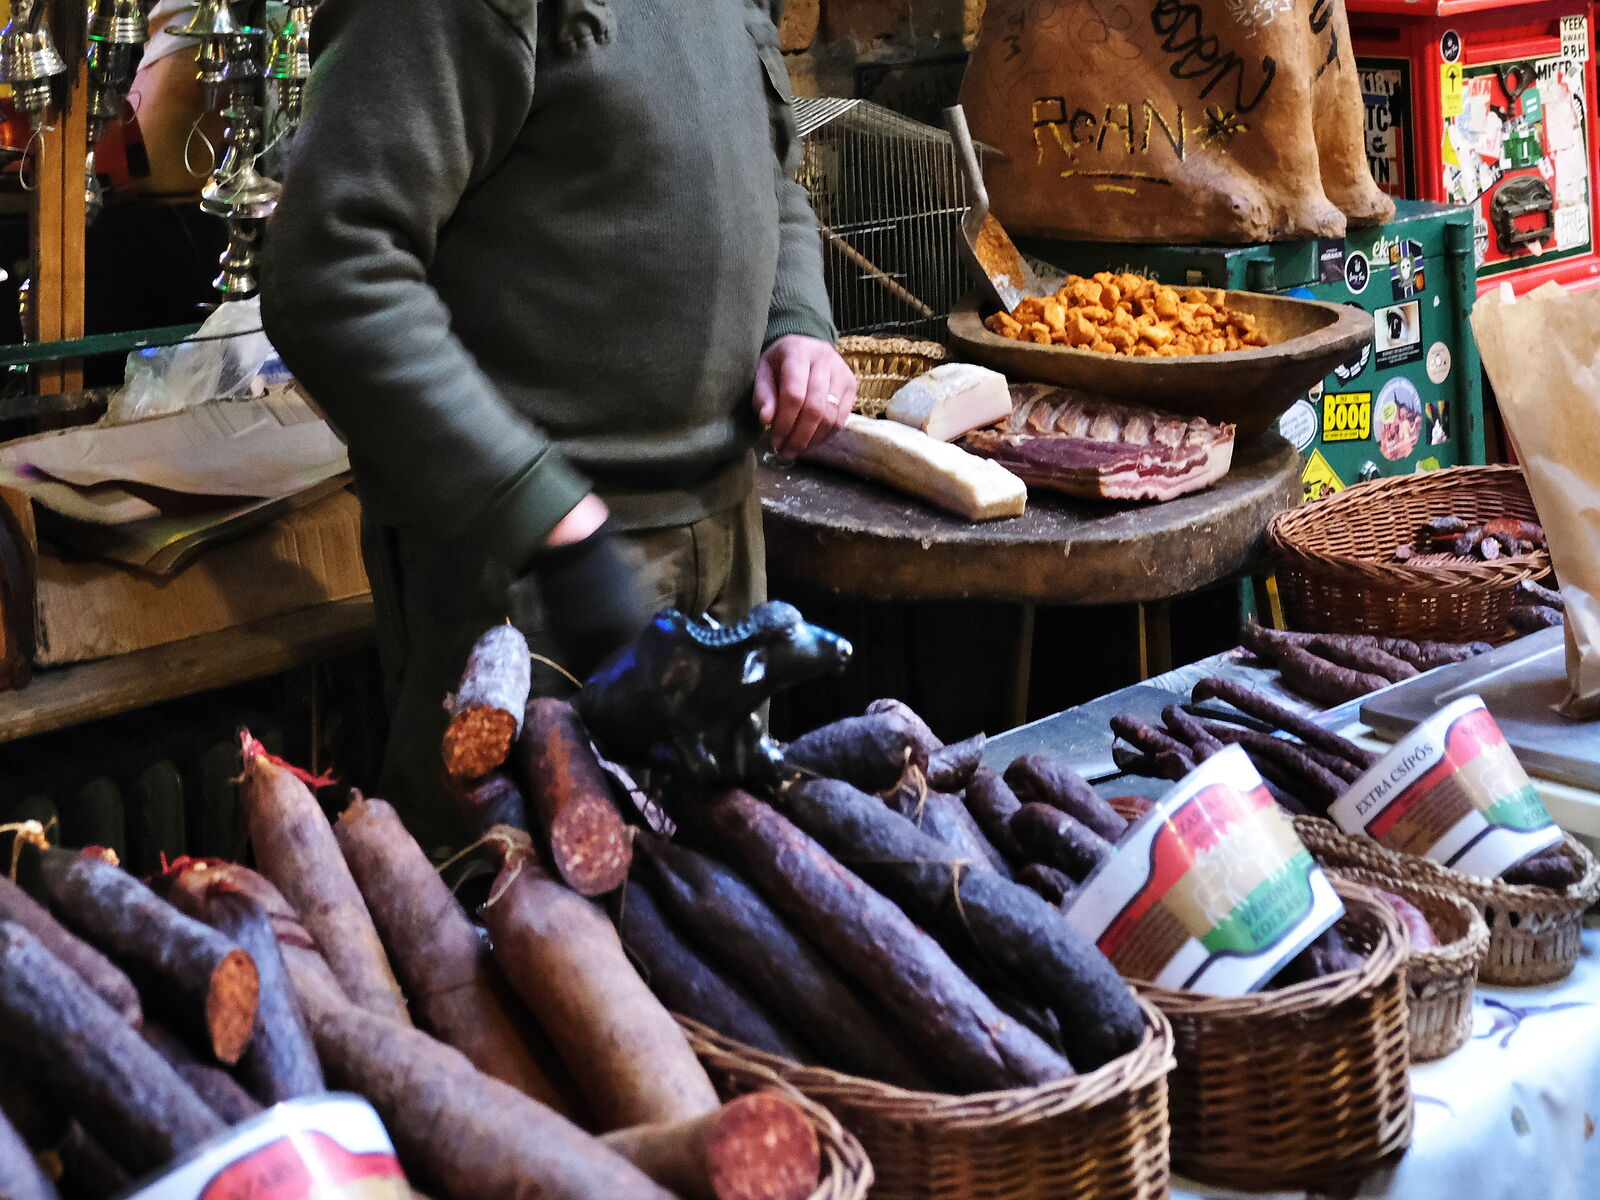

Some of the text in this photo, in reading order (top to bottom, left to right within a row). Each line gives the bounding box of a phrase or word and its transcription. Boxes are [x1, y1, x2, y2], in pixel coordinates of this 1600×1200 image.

[1324, 394, 1371, 440] Boog
[1355, 742, 1434, 816] EXTRA CSÍPŐS
